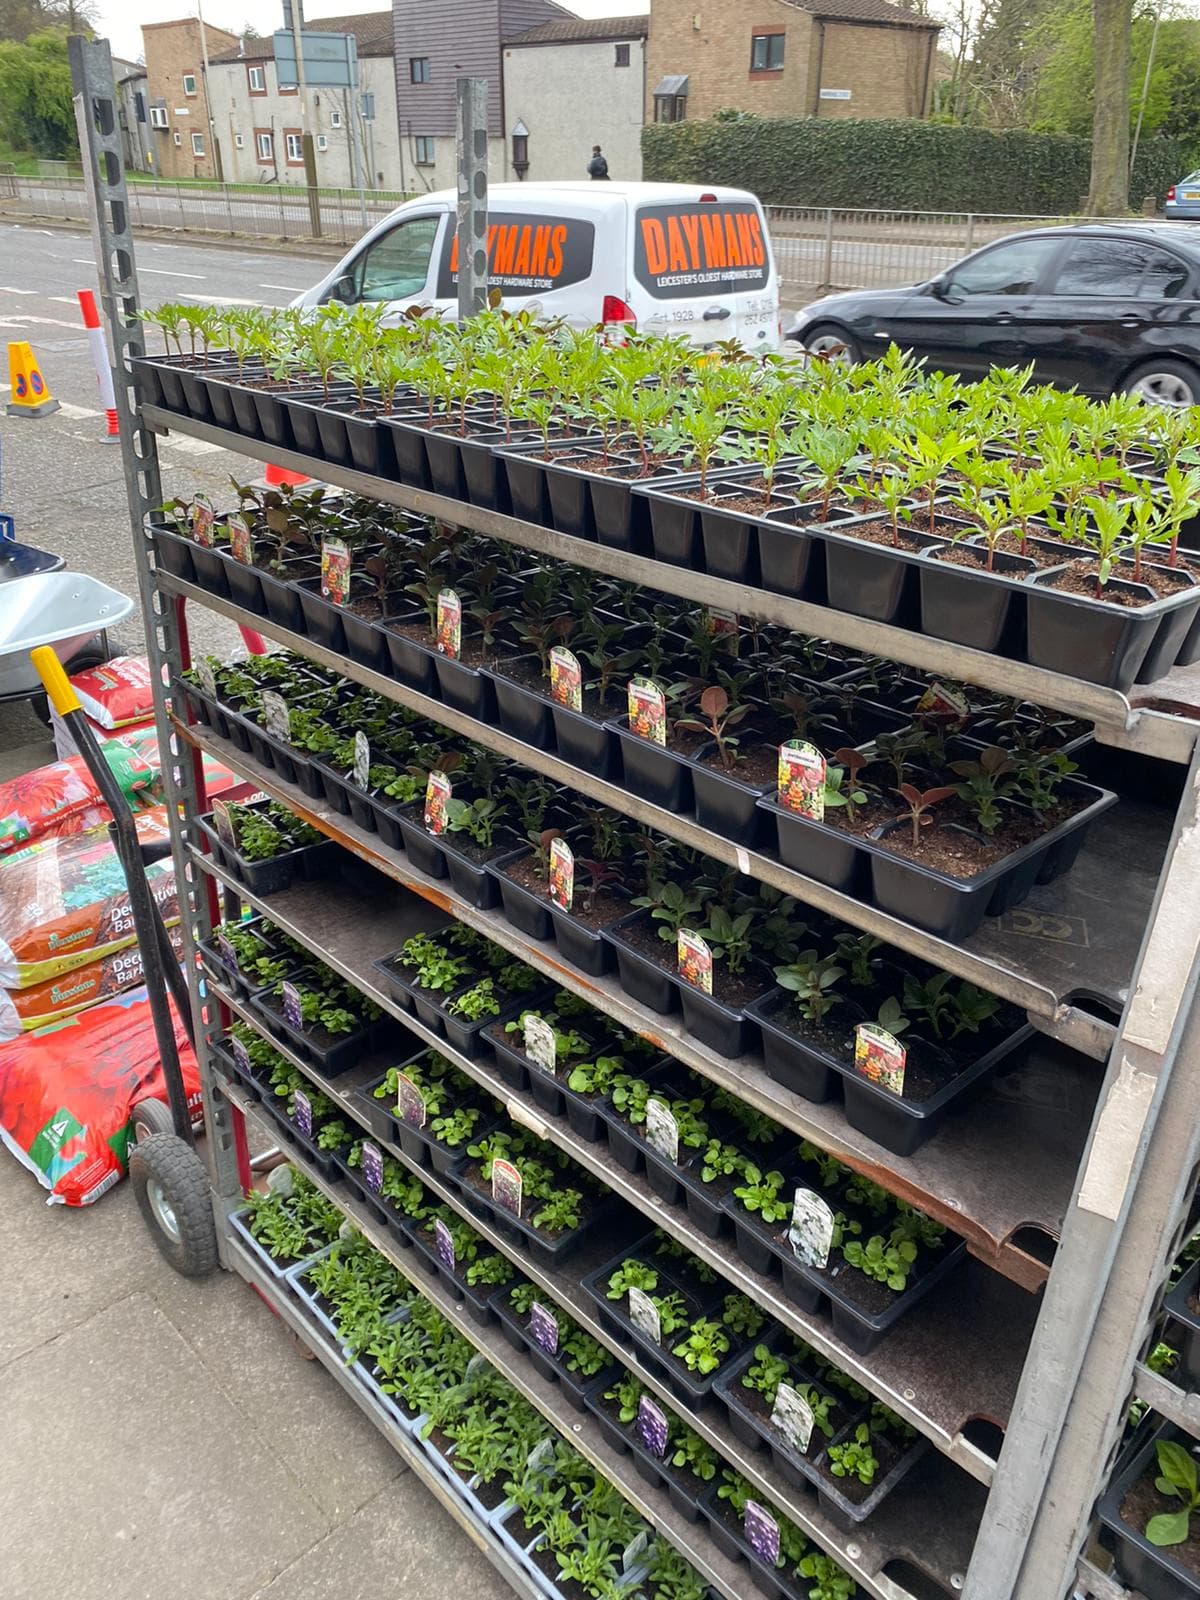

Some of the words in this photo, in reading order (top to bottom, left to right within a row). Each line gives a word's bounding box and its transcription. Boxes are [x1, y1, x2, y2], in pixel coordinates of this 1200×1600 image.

[641, 213, 765, 275] DAYMANS
[503, 277, 533, 288] HARDWARE
[534, 279, 553, 289] STORE
[657, 274, 698, 287] LEICESTER'S
[698, 272, 721, 283] OLDEST
[721, 270, 748, 281] HARDWARE
[748, 269, 763, 279] STORE
[672, 310, 695, 322] 1928
